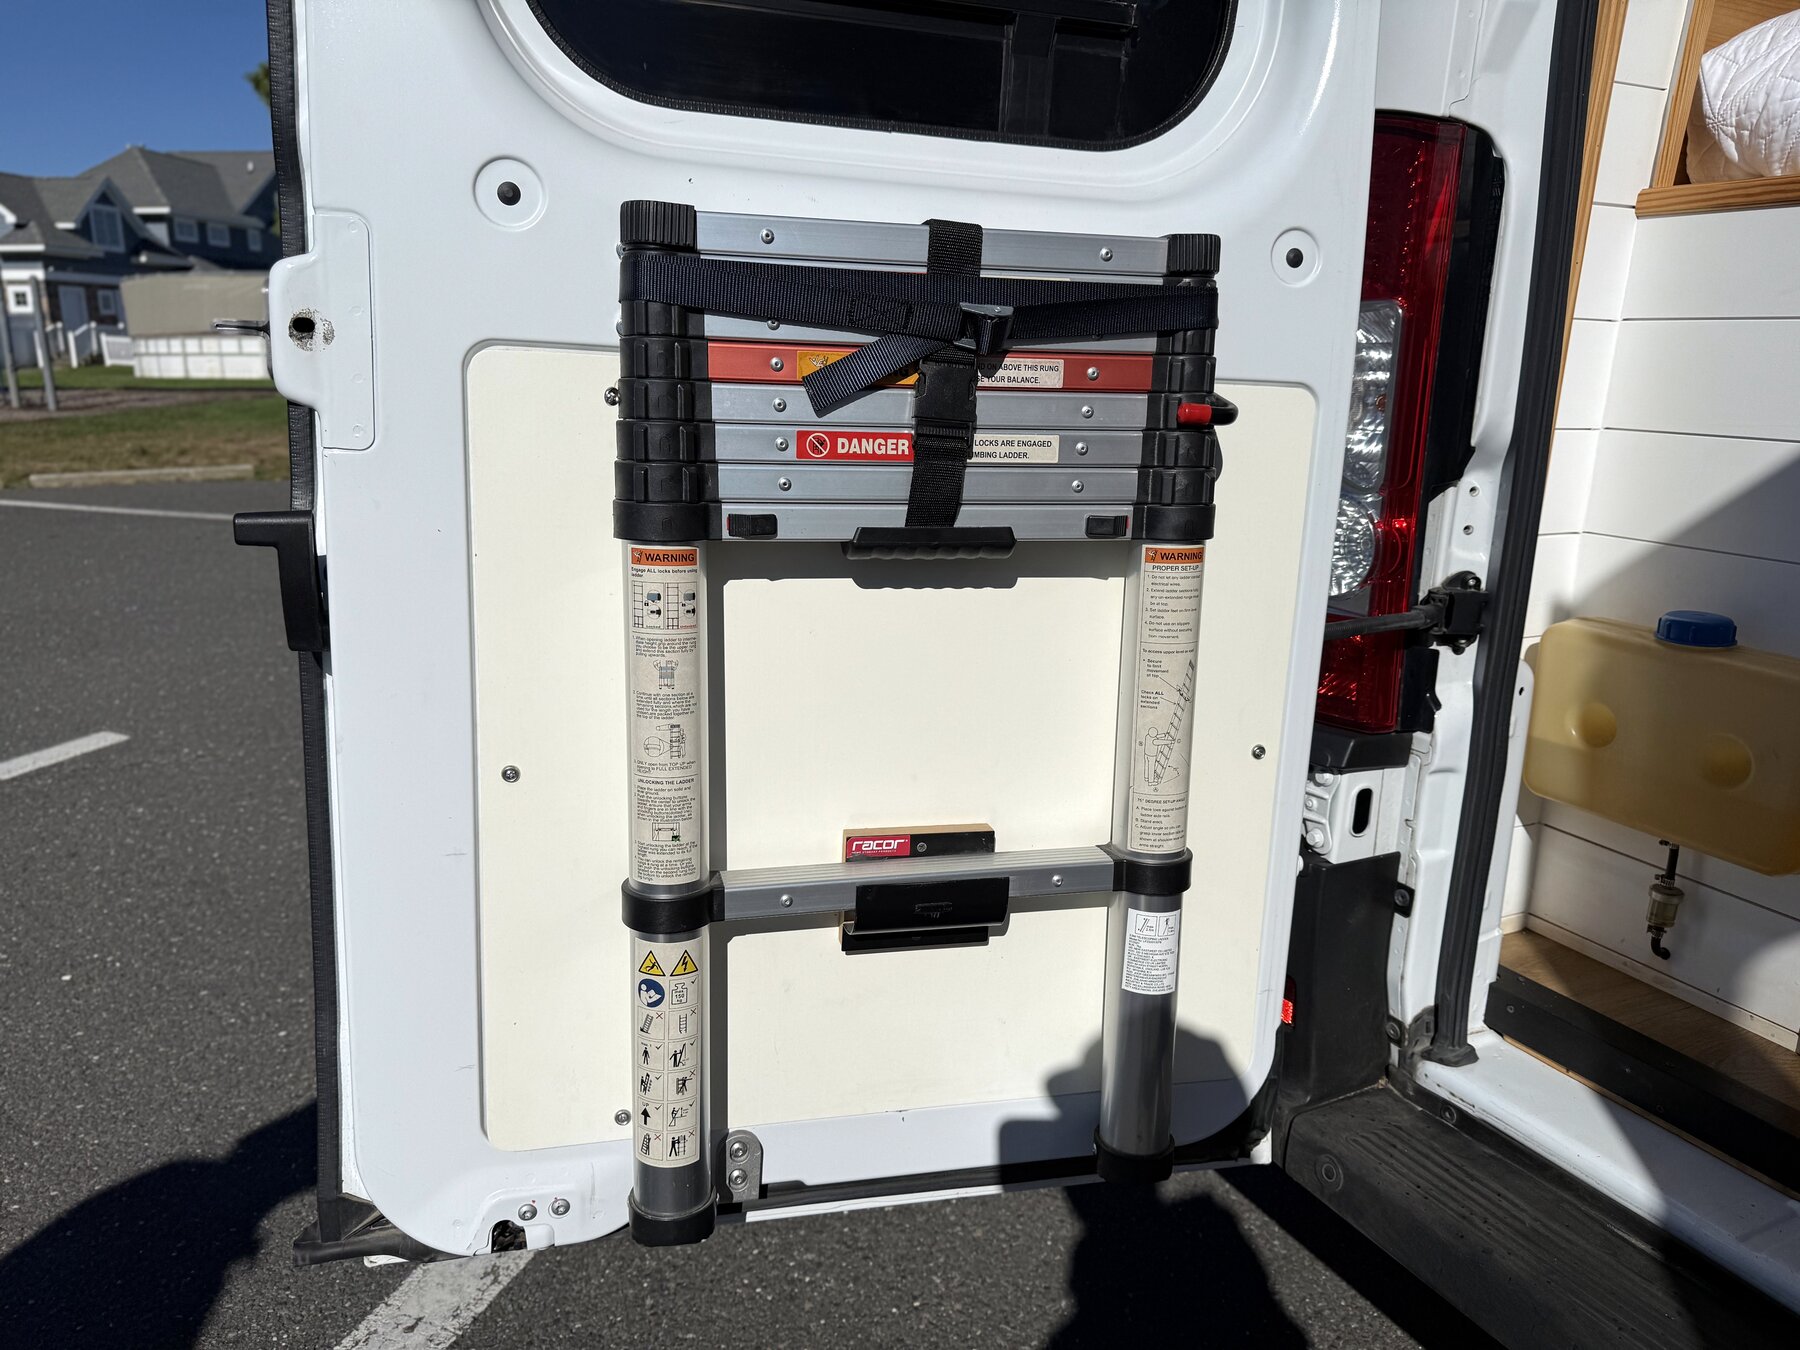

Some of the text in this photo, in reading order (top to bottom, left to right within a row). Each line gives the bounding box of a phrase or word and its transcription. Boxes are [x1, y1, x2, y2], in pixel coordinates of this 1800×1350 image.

[1024, 364, 1038, 372] THIS
[1040, 364, 1059, 372] RUNG
[1006, 376, 1040, 384] BALANCE.
[837, 438, 909, 454] DANGER
[1016, 440, 1052, 448] ENGAGED
[644, 553, 695, 562] WARNING
[1160, 552, 1202, 560] WARNING
[852, 839, 904, 851] racor
